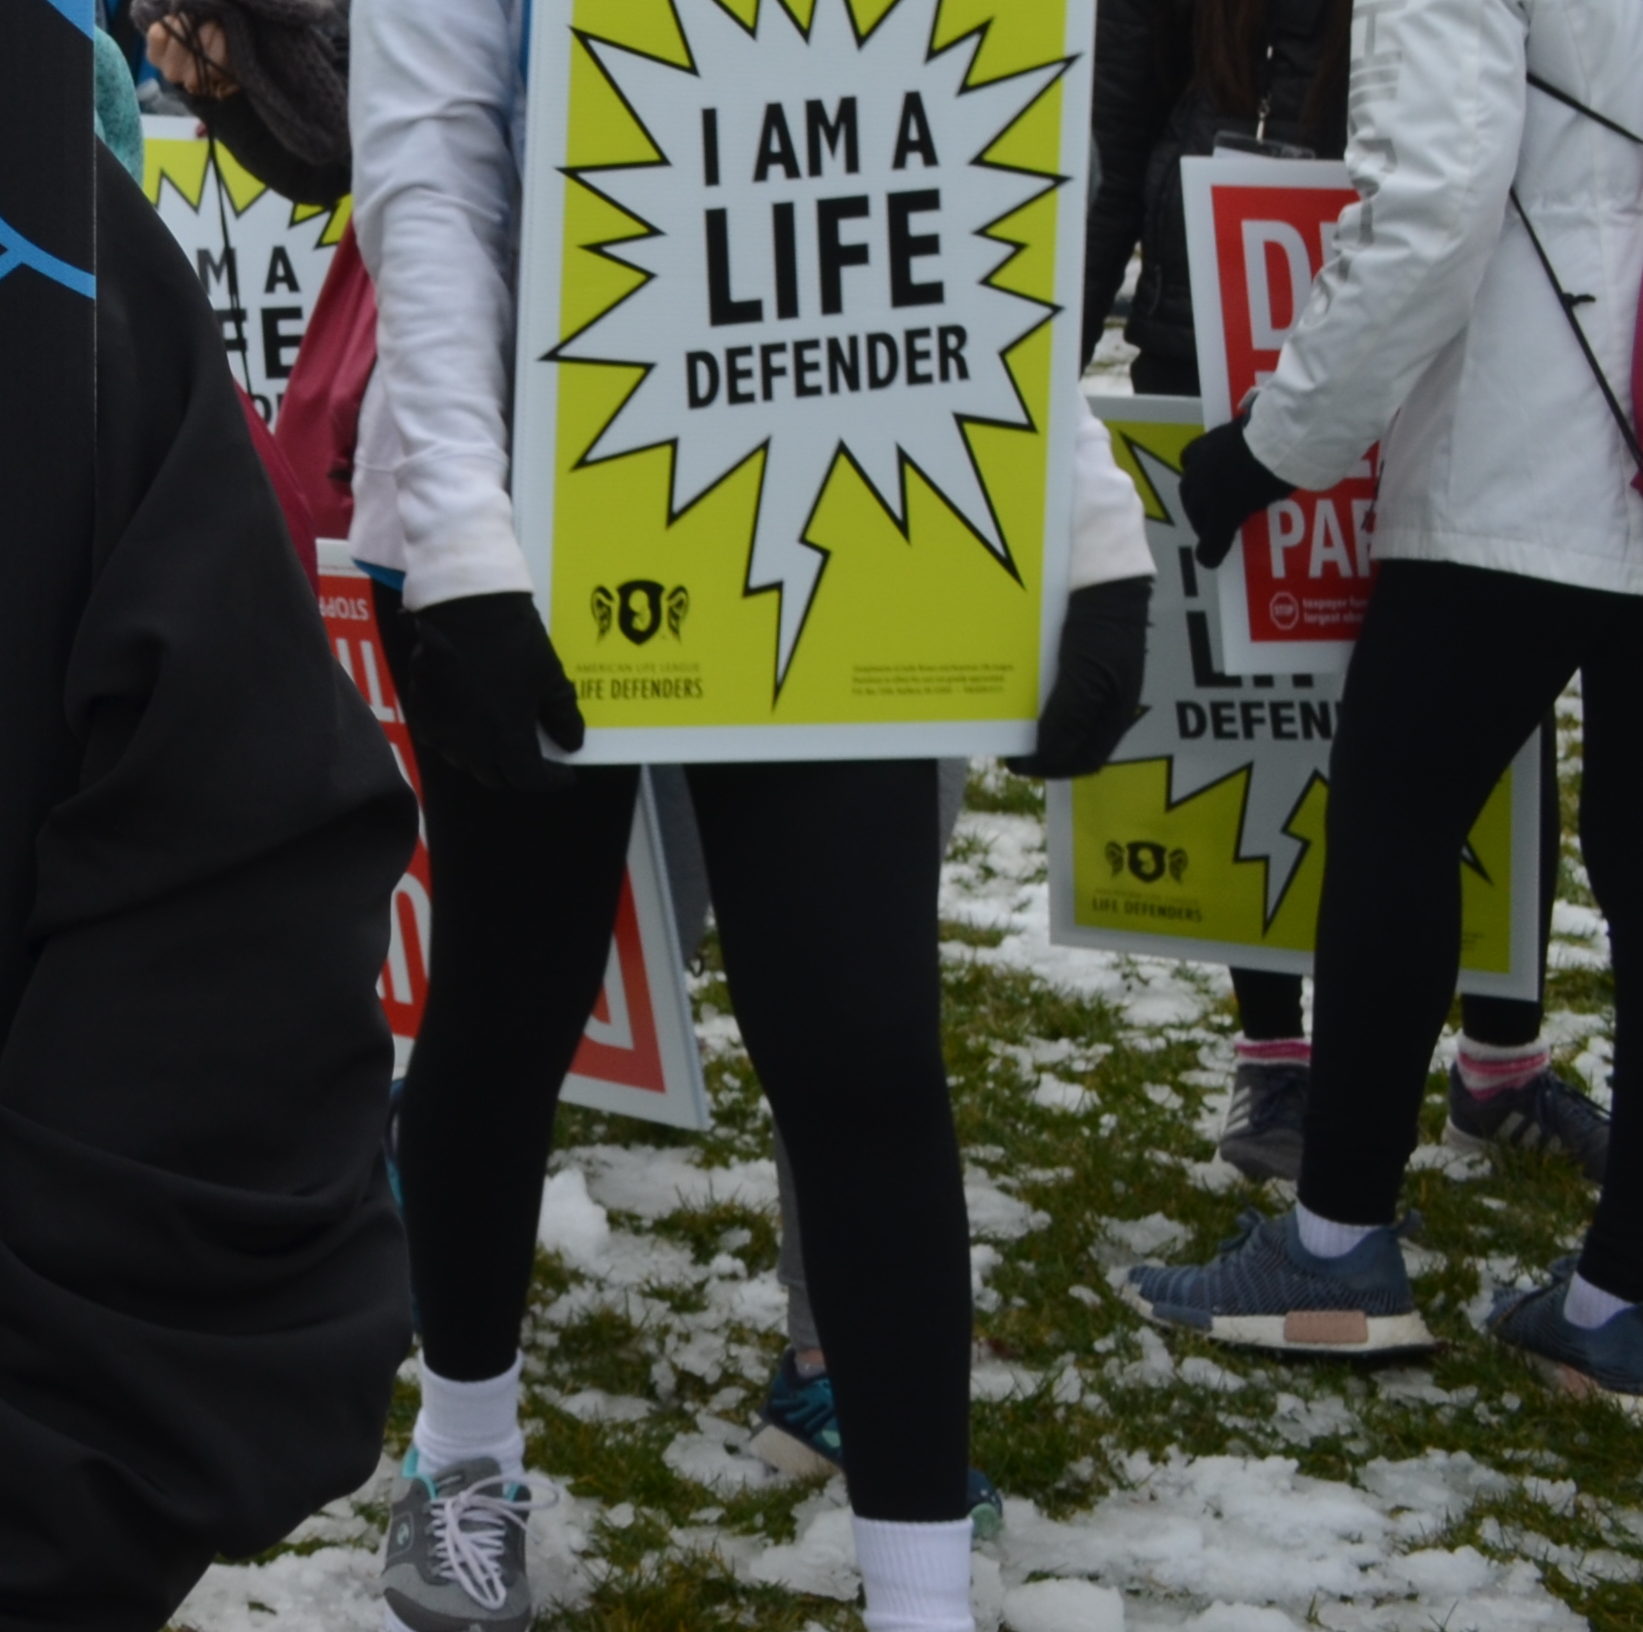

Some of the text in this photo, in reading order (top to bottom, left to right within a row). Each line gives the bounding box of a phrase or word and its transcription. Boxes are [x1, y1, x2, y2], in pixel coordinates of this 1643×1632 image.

[701, 90, 940, 187] I AM A
[264, 245, 301, 294] A
[704, 187, 945, 327] LIFE
[685, 323, 970, 410] DEFENDER
[572, 677, 704, 700] IFE DEFENDERS
[1175, 700, 1342, 741] DEFEN
[1124, 900, 1203, 922] DEFENDERS
